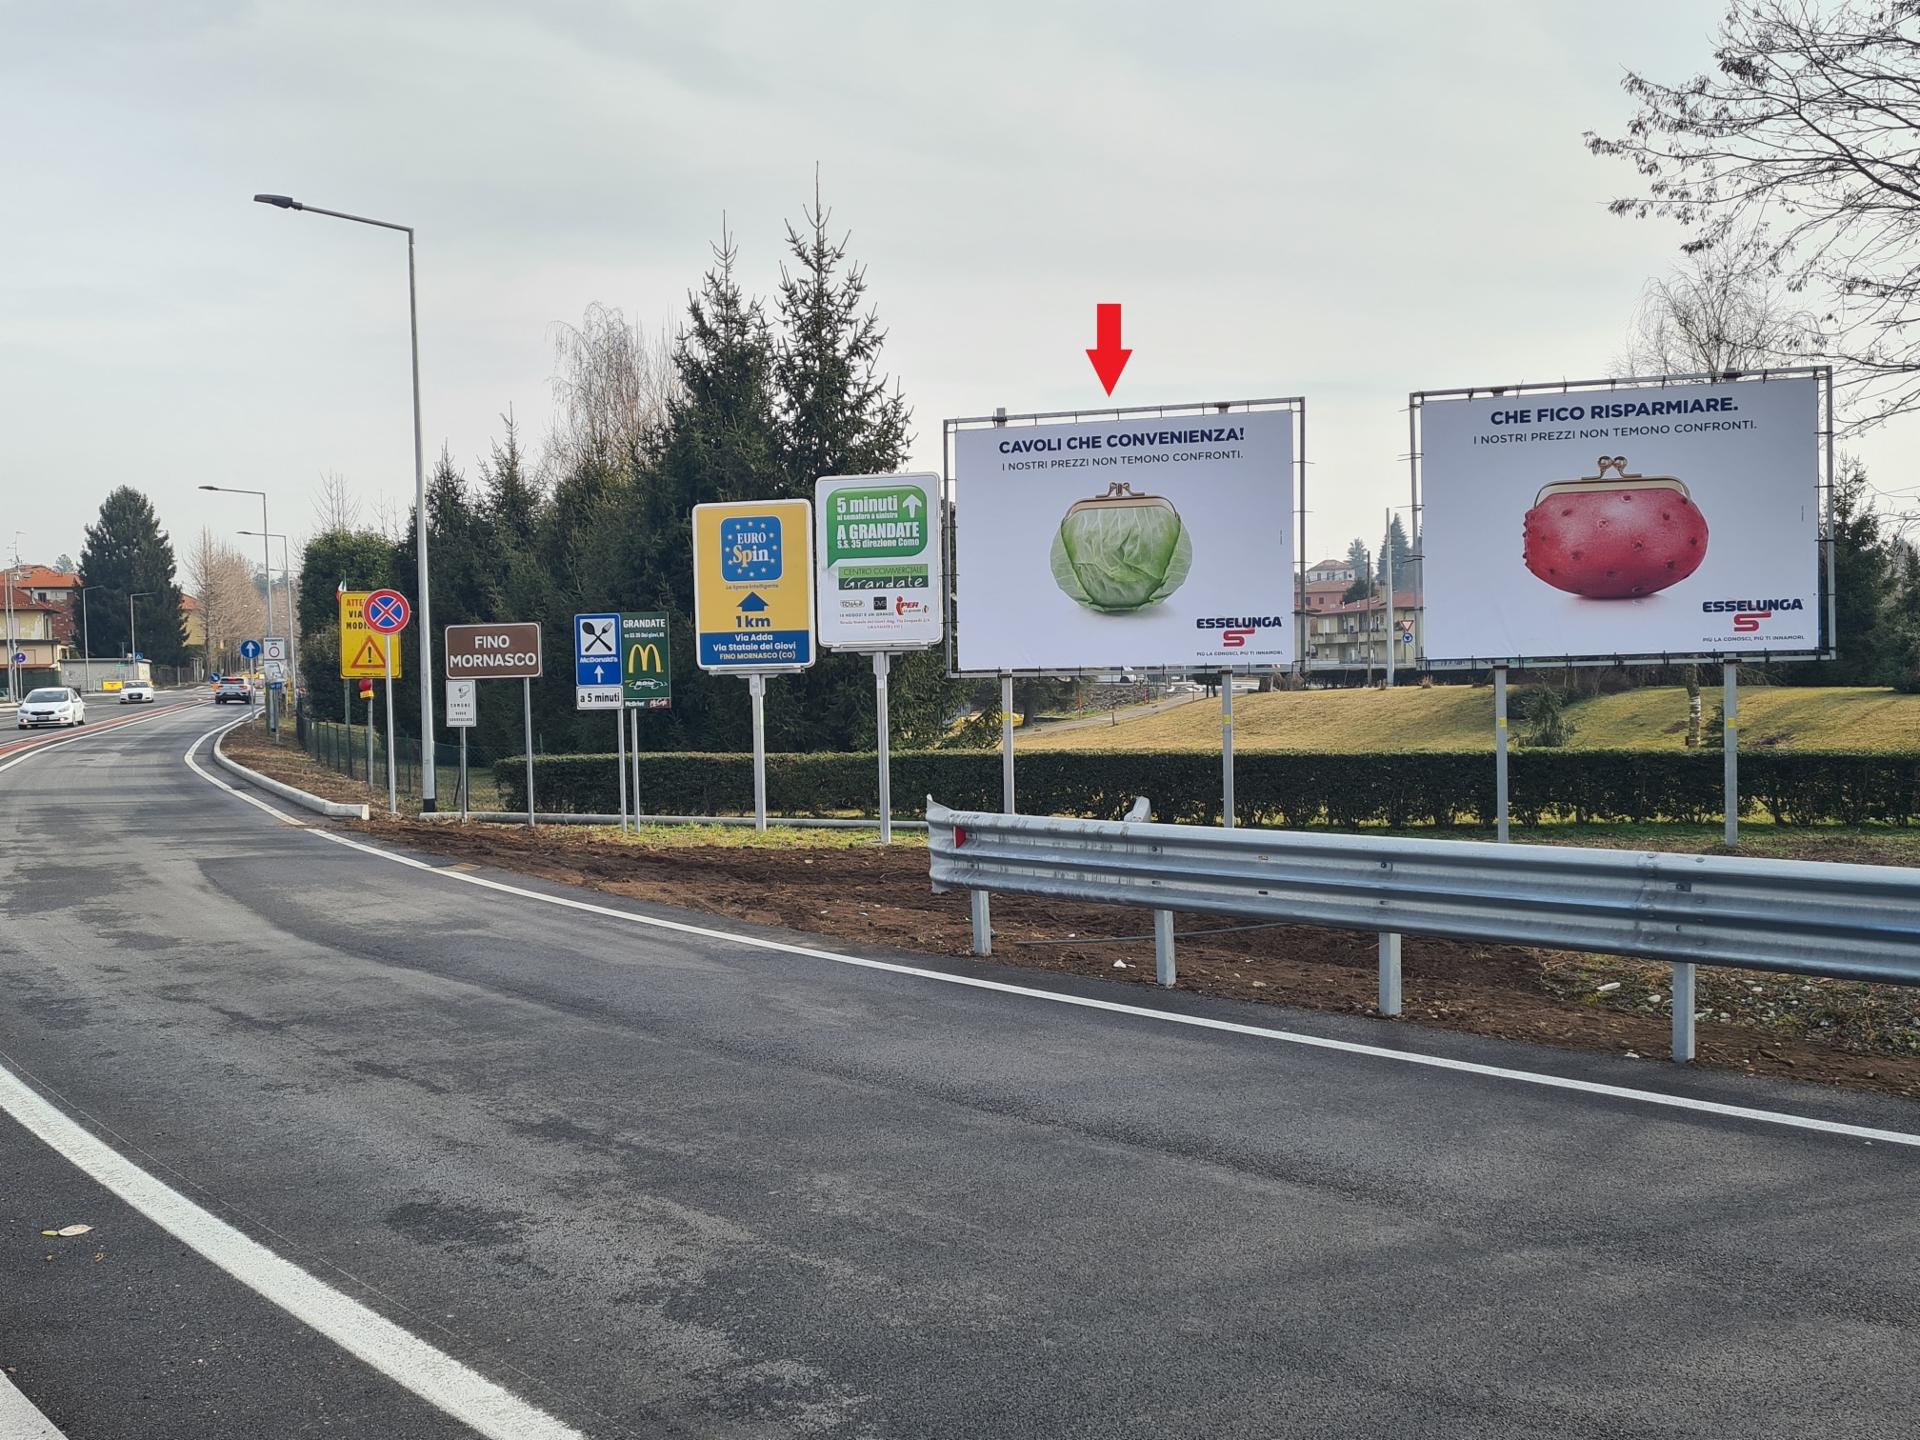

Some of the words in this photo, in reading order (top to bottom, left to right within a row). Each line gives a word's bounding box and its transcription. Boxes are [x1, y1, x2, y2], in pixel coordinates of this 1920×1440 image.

[1490, 410, 1532, 426] CHE
[1537, 406, 1585, 423] FICO
[1590, 397, 1739, 420] RISPARMIARE.
[1473, 435, 1477, 445] I
[1480, 433, 1527, 444] NOSTRI
[1531, 430, 1576, 442] PREZZI
[1580, 428, 1609, 440] NON
[1613, 424, 1670, 437] TEMONO
[1674, 420, 1758, 434] CONFRONTI.
[999, 438, 1062, 454] CAVOLI
[1066, 435, 1102, 450] CHE
[1106, 427, 1245, 449] CONVENIENZA!
[1001, 461, 1005, 471] I
[1008, 459, 1048, 471] NOSTRI
[1051, 457, 1089, 468] PREZZI
[1092, 455, 1118, 467] NON
[1120, 453, 1170, 465] TEMONO
[1172, 449, 1244, 462] CONFRONTI.
[836, 497, 847, 514] 5
[849, 495, 898, 513] minuti
[836, 524, 846, 540] A
[849, 521, 920, 540] GRANDATE
[737, 532, 767, 544] EURO
[851, 539, 861, 549] 35
[862, 538, 897, 548] direzione
[897, 537, 920, 547] Como
[732, 544, 770, 567] Spin
[843, 568, 872, 576] CENTRO
[874, 565, 923, 575] COMMERCIALE
[843, 574, 925, 589] Grandate
[346, 598, 364, 607] ATTE
[1702, 598, 1804, 613] ESSELUNGA
[346, 622, 370, 630] MODI
[622, 619, 666, 628] GRANDATE
[735, 615, 742, 628] 1
[745, 615, 771, 628] km
[1196, 616, 1282, 629] ESSELUNGA
[474, 635, 510, 649] FINO
[734, 634, 749, 642] Via
[750, 633, 773, 641] Adda
[712, 644, 727, 652] Via
[728, 642, 759, 651] Statale
[760, 642, 773, 650] dei
[774, 641, 797, 650] Giovi
[449, 652, 537, 668] MORNASCO
[736, 652, 778, 660] MORNASCO
[778, 650, 796, 660] (CO)
[580, 694, 586, 703] a
[587, 693, 593, 702] 5
[594, 692, 620, 703] minuti
